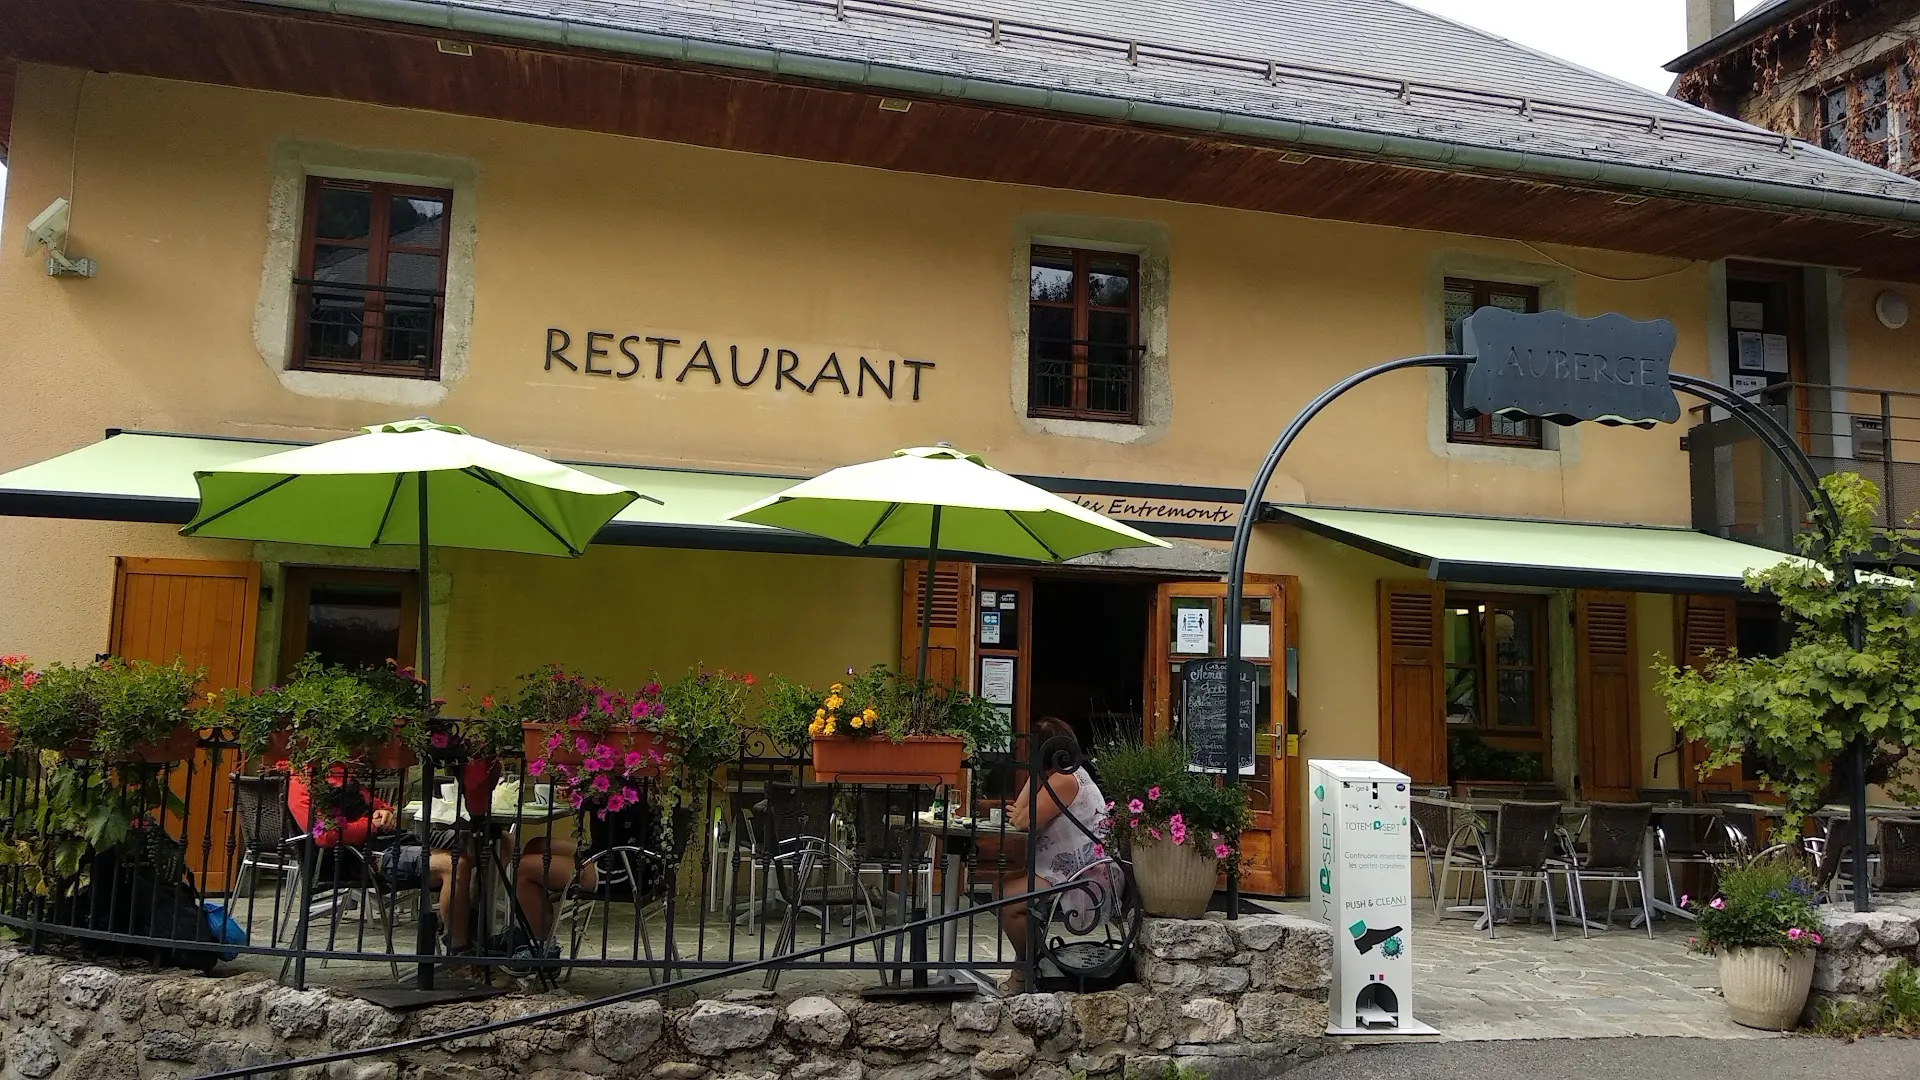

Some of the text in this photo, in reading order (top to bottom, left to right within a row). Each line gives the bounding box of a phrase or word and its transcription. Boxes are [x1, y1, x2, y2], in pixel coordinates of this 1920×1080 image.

[544, 328, 936, 401] RESTAURANT
[1498, 345, 1656, 387] AUBERGE
[1107, 499, 1234, 523] Entremonts
[1344, 851, 1378, 860] Continuons
[1345, 900, 1366, 910] PUSH
